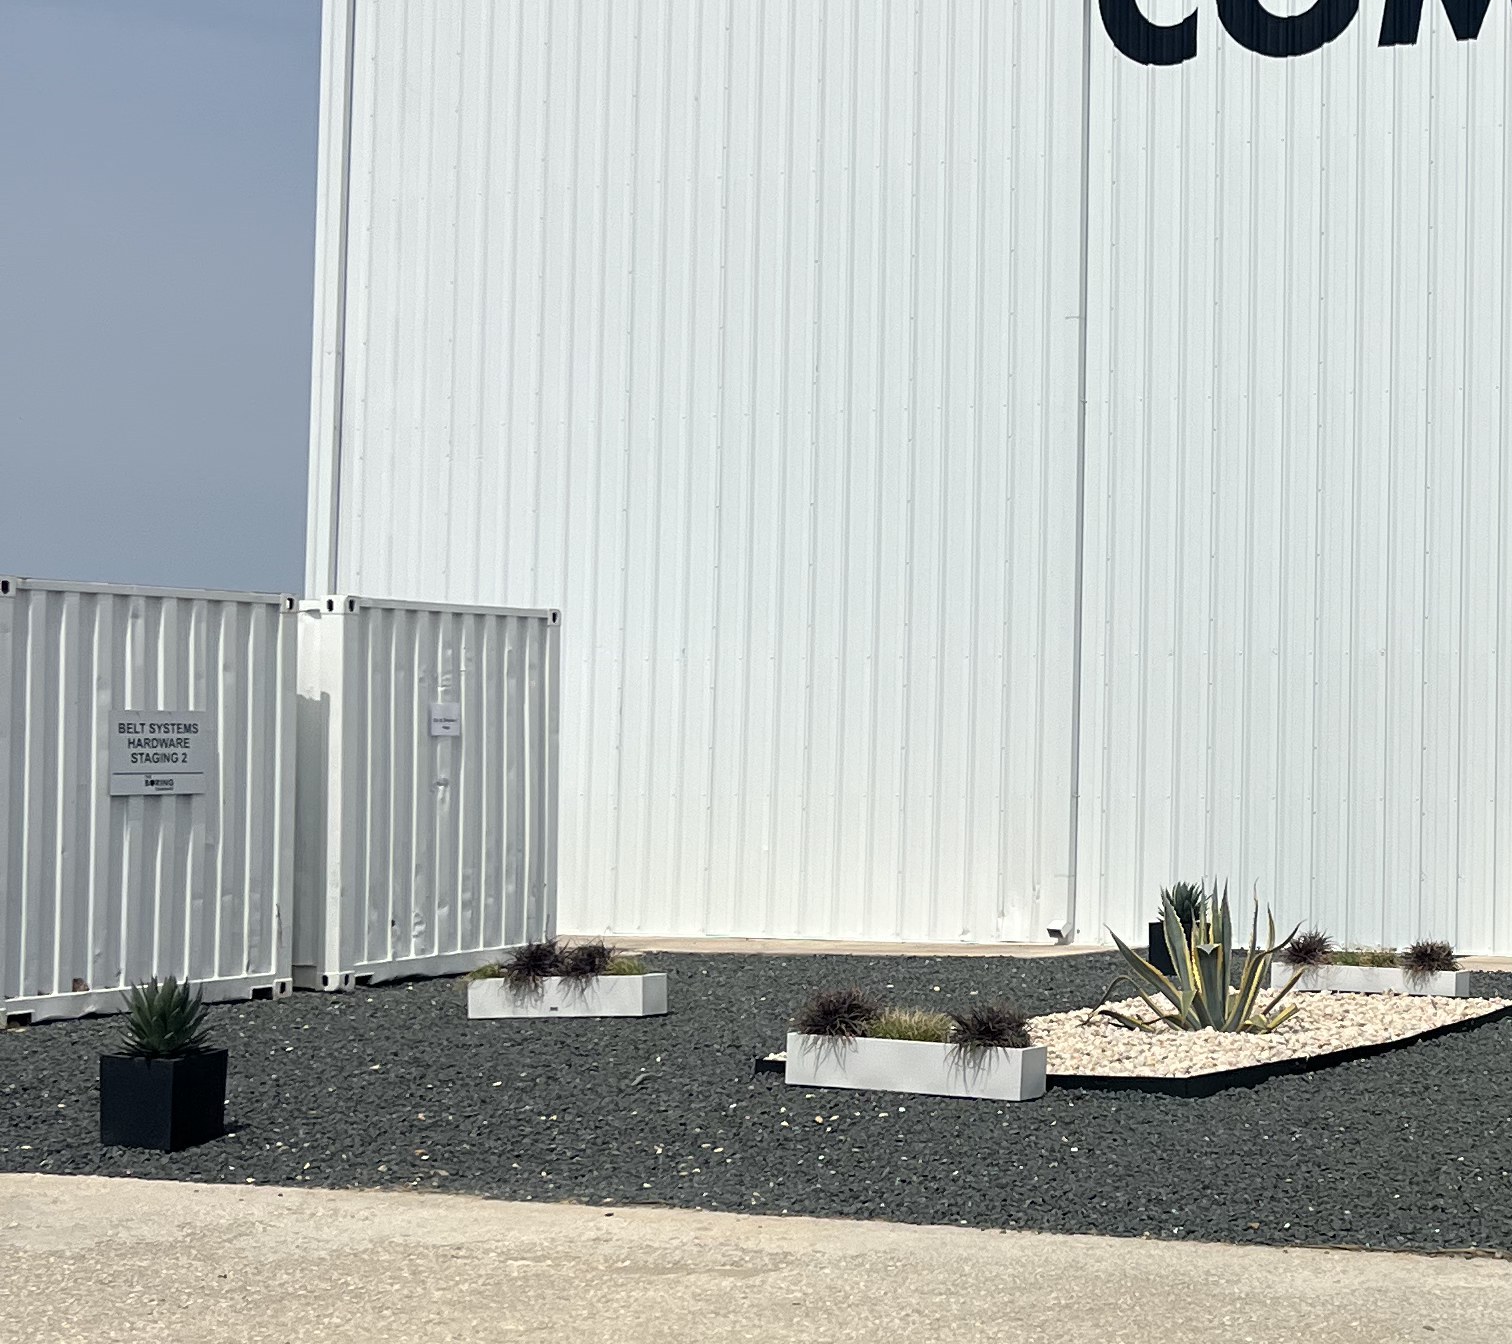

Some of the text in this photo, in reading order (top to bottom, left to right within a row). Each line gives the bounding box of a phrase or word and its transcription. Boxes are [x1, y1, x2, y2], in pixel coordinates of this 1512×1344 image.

[118, 722, 199, 734] BELT SYSTEMS
[127, 737, 191, 749] HARDWARE
[130, 752, 188, 764] STAGING 2
